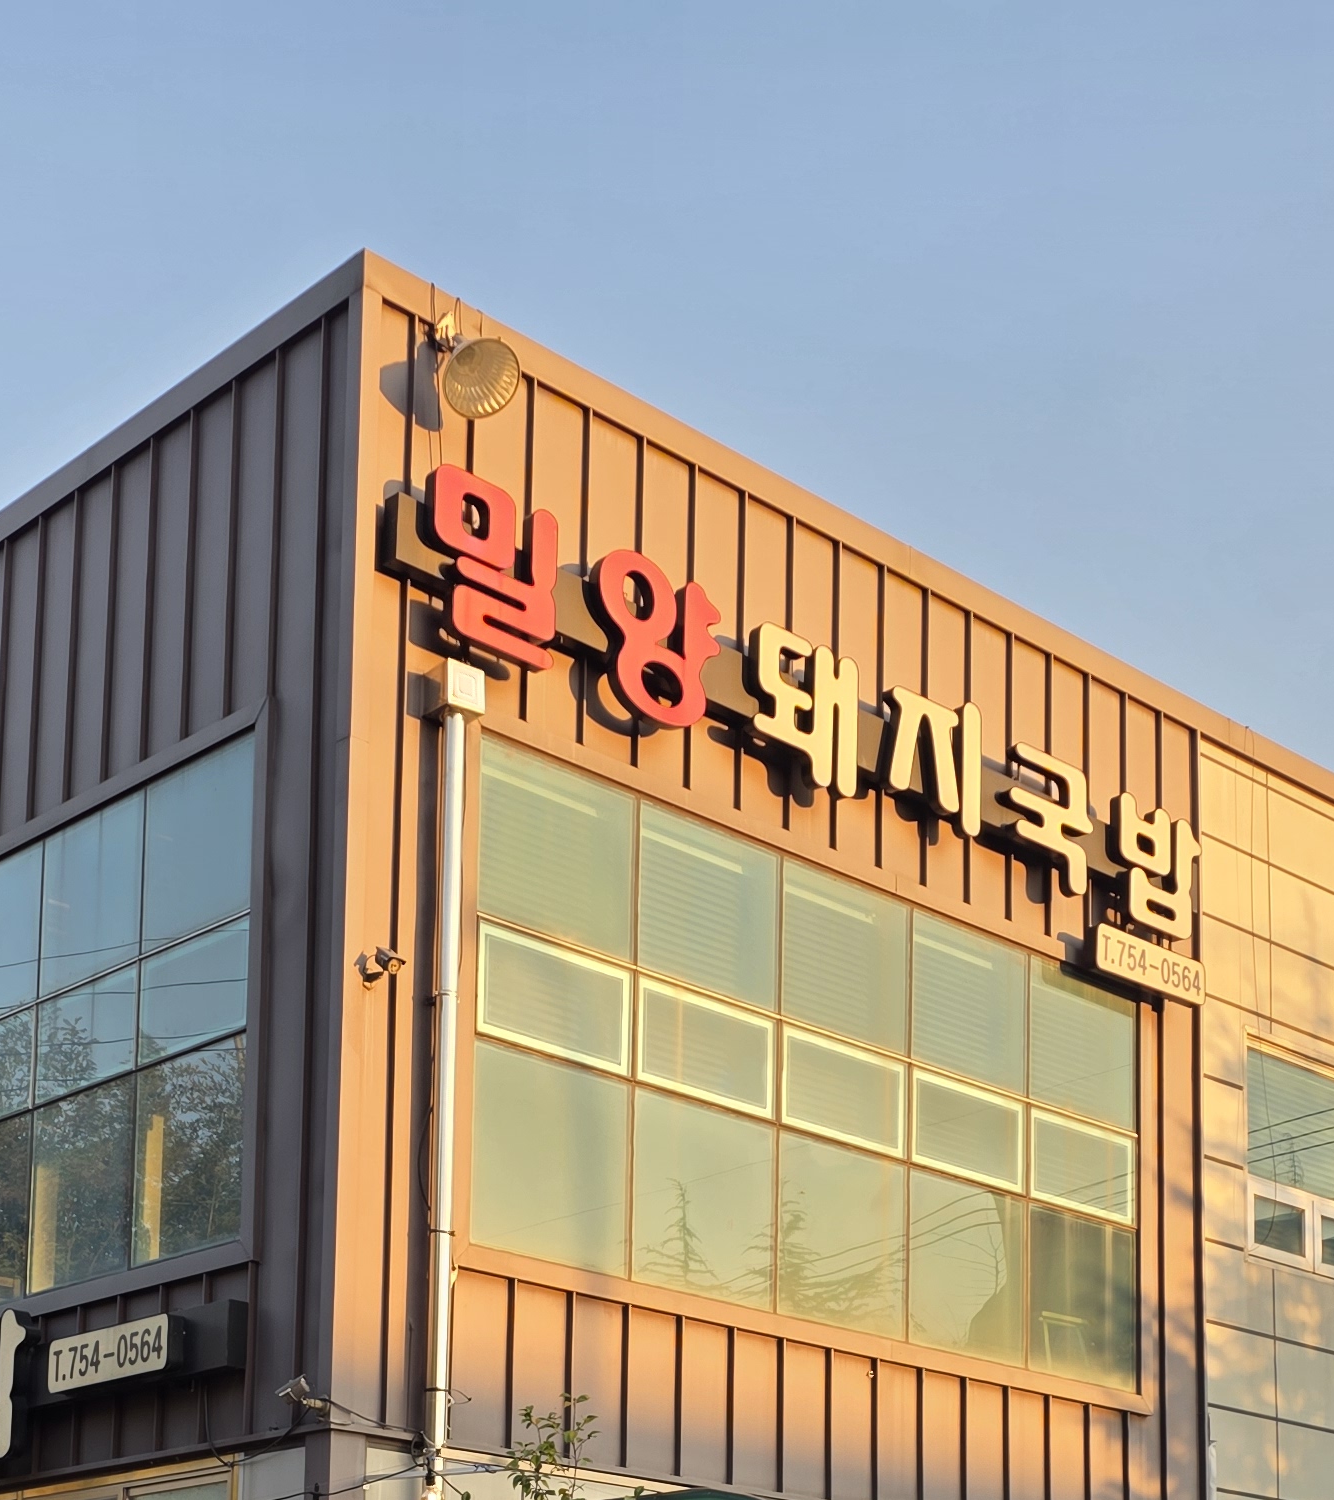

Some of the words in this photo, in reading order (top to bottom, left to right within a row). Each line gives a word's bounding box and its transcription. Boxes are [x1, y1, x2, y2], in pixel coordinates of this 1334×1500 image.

[433, 463, 722, 728] 밀양
[753, 621, 1202, 940] 돼지국밥
[1101, 933, 1202, 997] T.754-0564
[52, 1325, 164, 1383] T.754-0564
